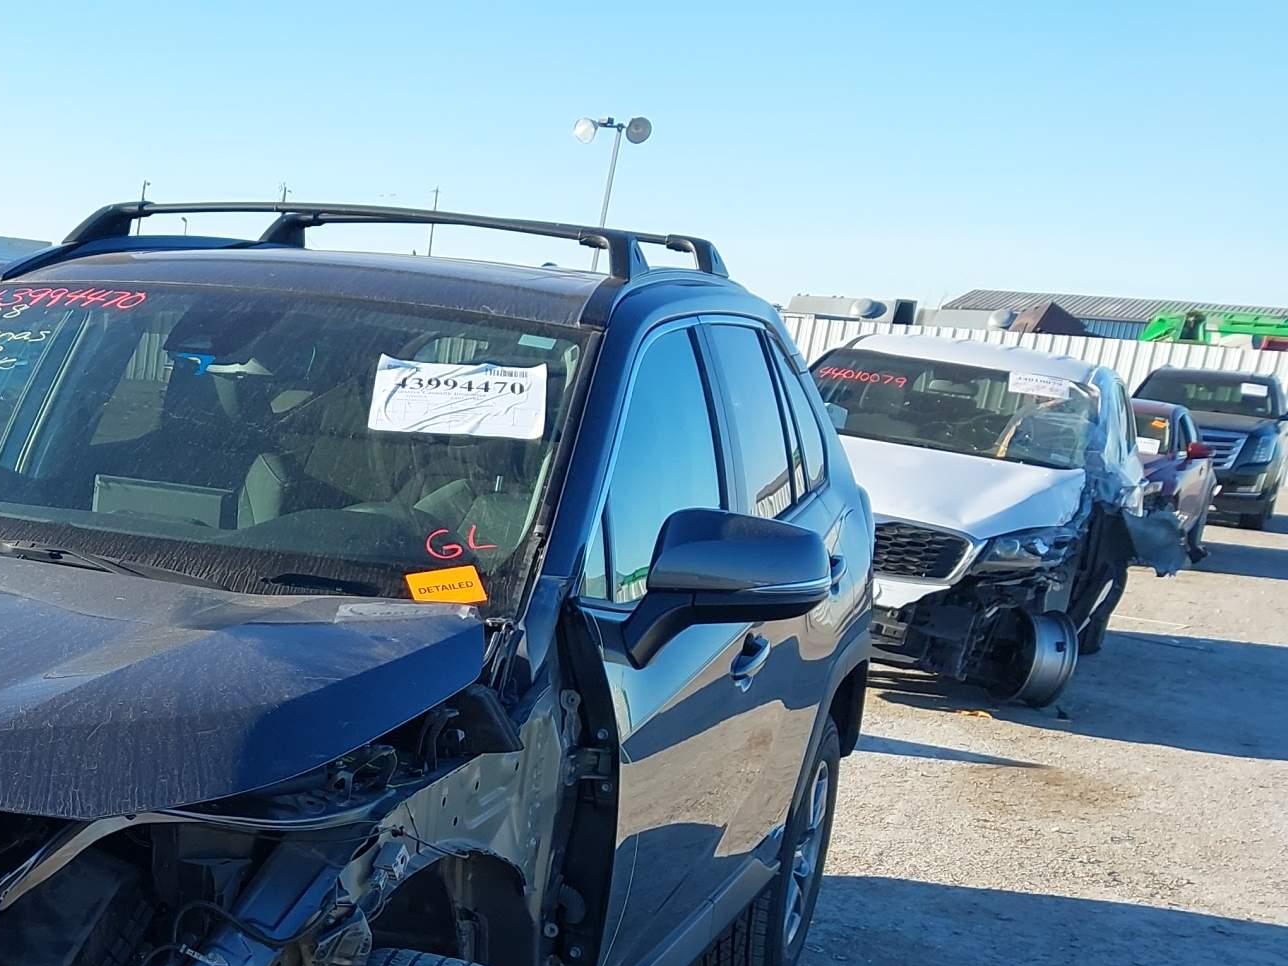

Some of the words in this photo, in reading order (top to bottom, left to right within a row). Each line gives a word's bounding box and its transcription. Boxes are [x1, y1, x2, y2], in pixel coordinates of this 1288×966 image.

[395, 377, 525, 395] 43994470
[818, 365, 908, 389] 44010079
[418, 580, 474, 596] DETAILED
